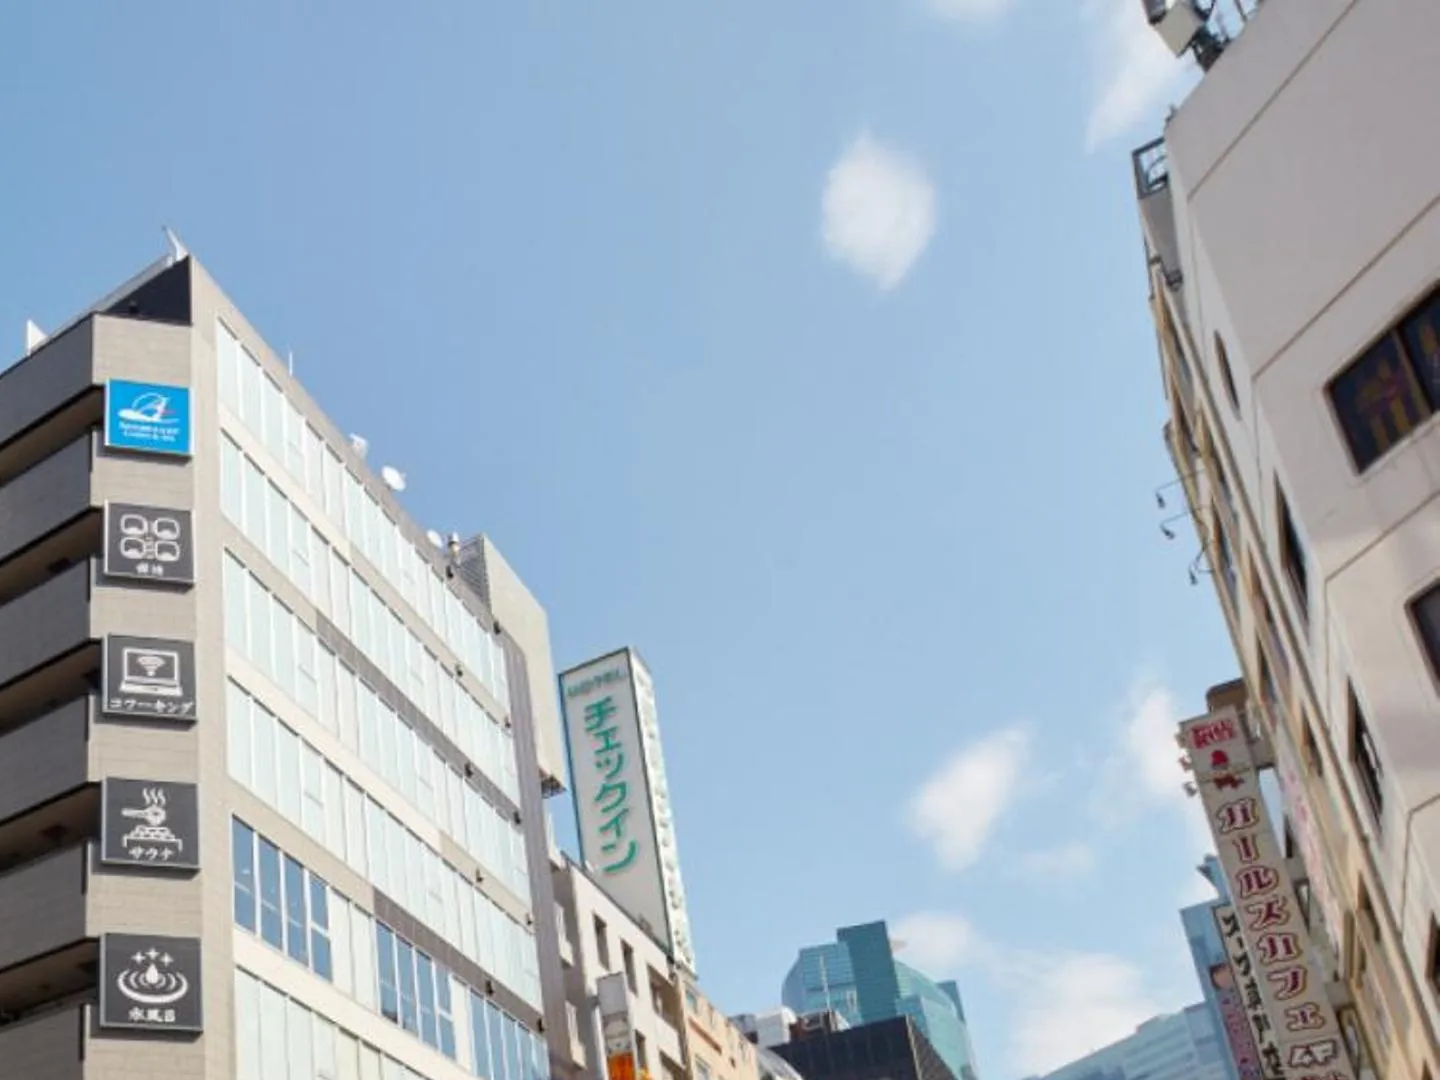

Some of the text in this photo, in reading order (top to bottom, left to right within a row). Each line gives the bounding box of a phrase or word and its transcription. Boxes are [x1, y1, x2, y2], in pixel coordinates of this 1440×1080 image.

[110, 698, 194, 716] コワーキング
[583, 697, 638, 874] チェックイン
[128, 847, 174, 861] サウナ
[128, 1006, 176, 1023] 水風呂
